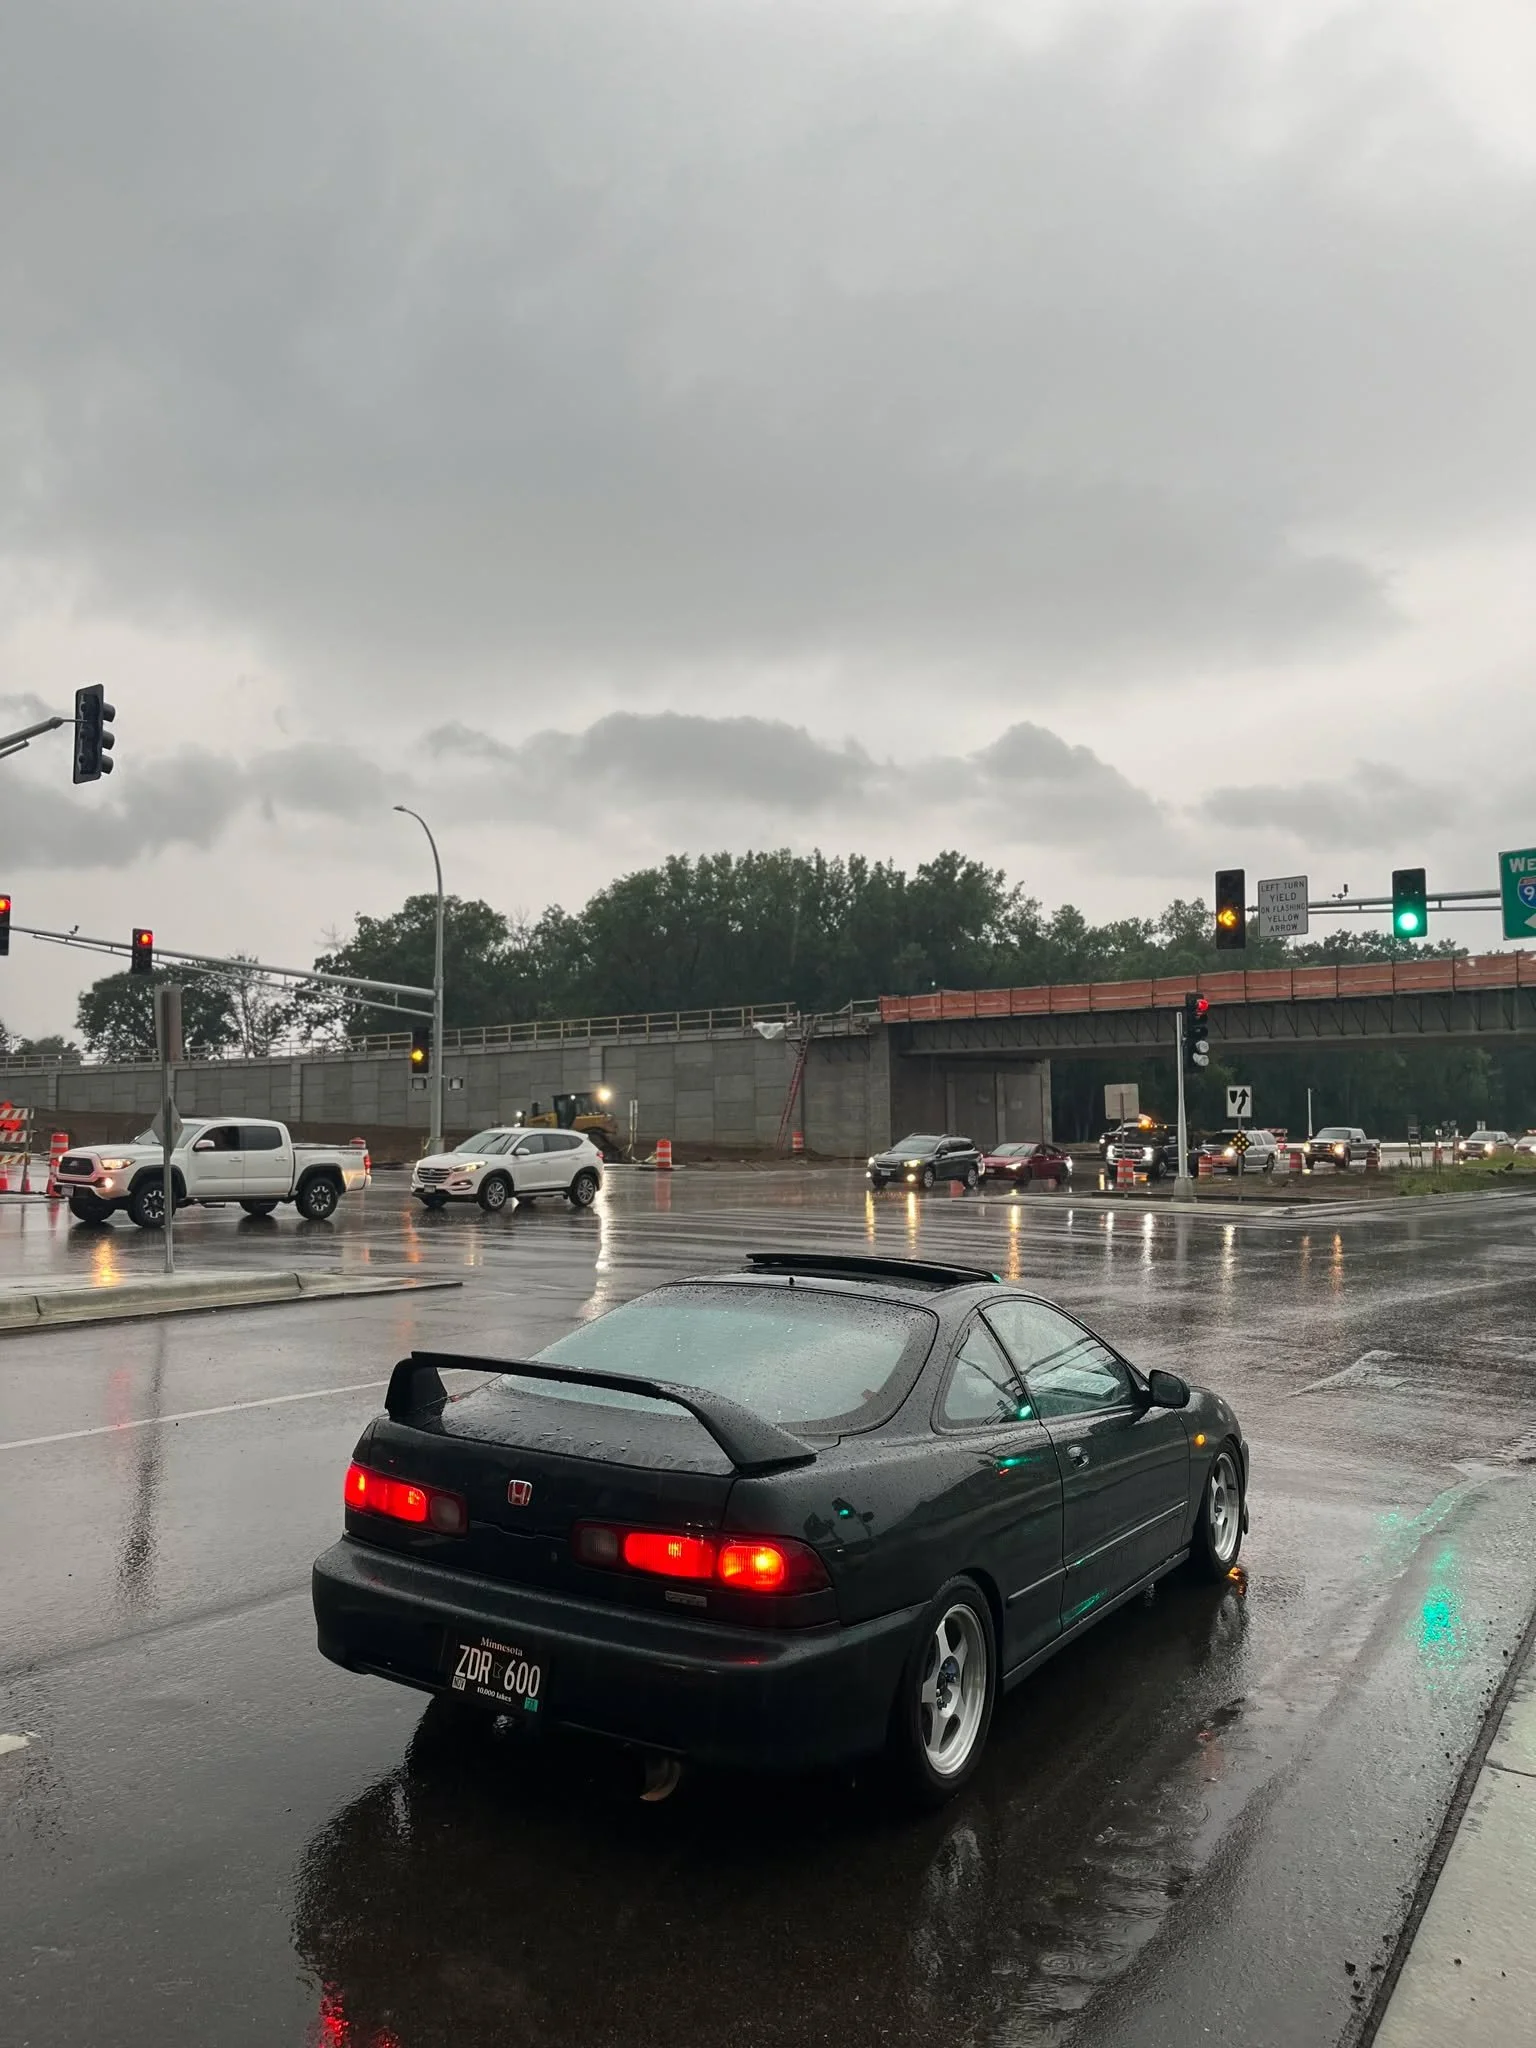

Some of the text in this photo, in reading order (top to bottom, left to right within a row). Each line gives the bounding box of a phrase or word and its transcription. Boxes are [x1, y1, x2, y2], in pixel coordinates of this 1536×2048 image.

[1261, 880, 1305, 892] LEFT TURN
[1269, 892, 1297, 903] YIELD
[1261, 902, 1305, 914] ON FLASHING
[1267, 913, 1299, 923] YELLOW
[1269, 923, 1297, 932] ARROW
[480, 1636, 523, 1657] Minnesota
[455, 1644, 541, 1698] ZDR 600
[477, 1686, 496, 1698] 10,000
